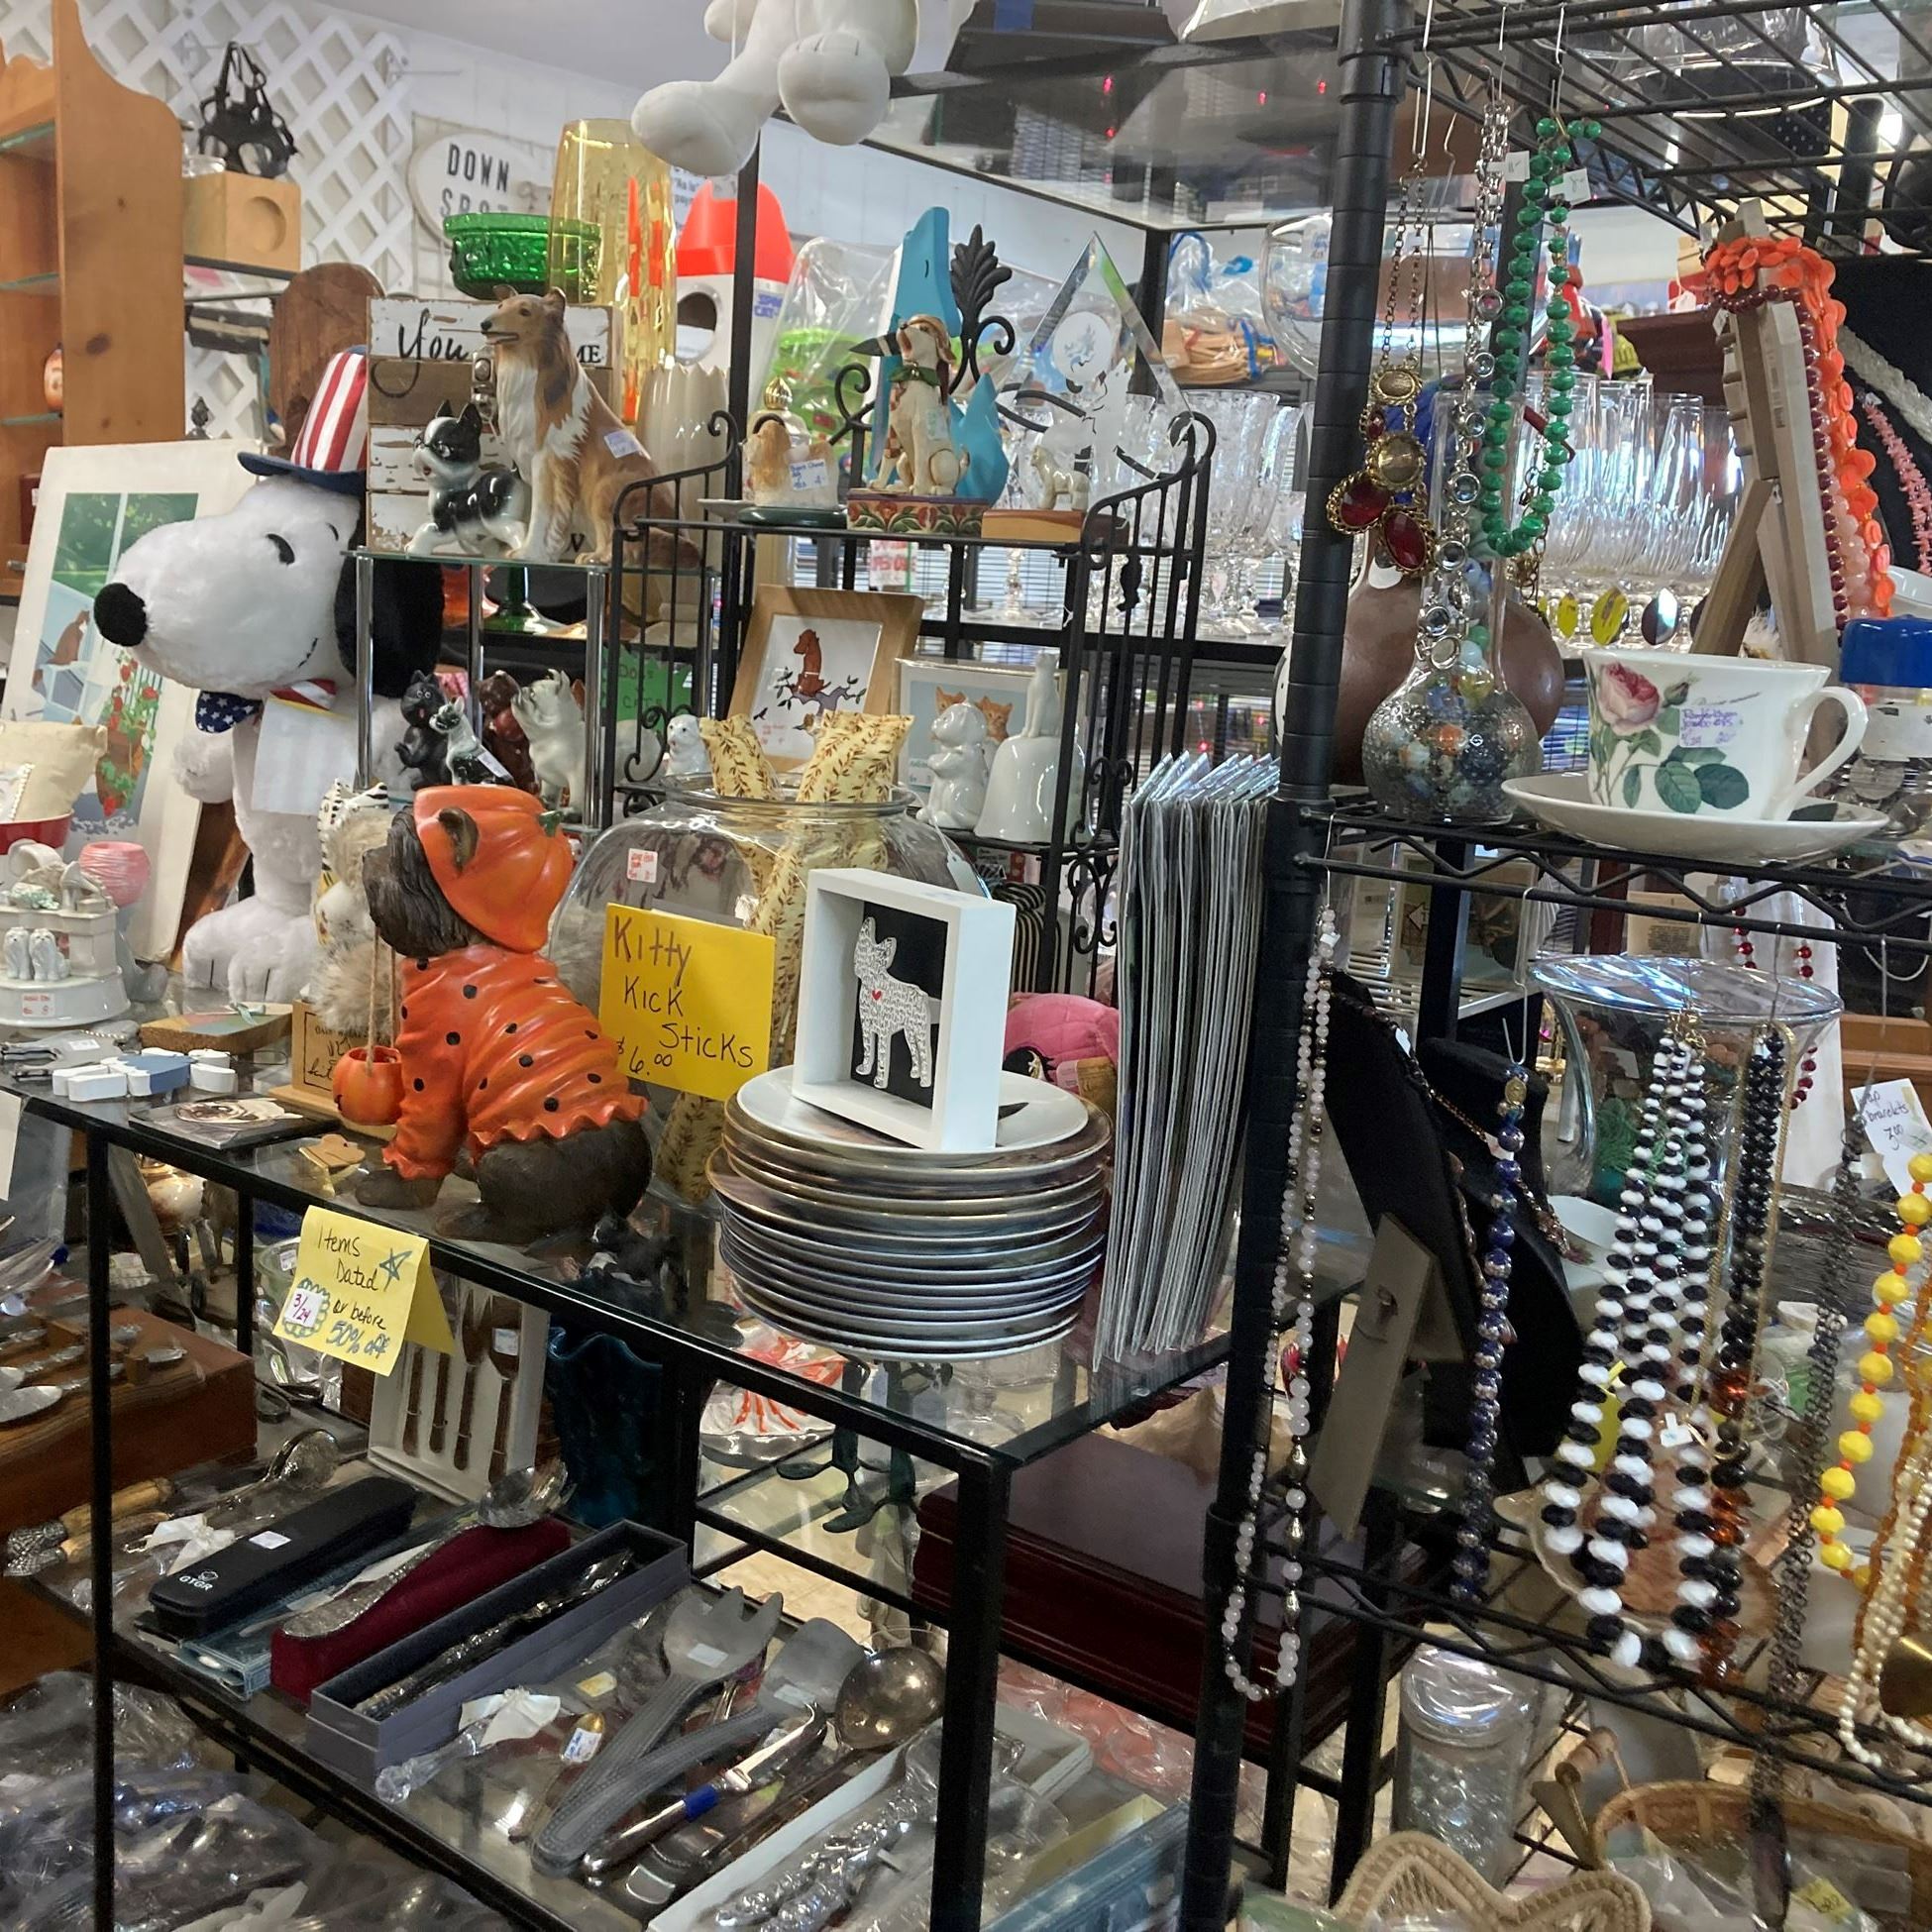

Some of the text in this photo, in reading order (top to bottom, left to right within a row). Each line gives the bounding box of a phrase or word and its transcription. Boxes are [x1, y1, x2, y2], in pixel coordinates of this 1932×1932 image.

[447, 143, 509, 193] DOWN
[372, 308, 469, 398] You
[614, 915, 692, 989] Kitty
[317, 1224, 361, 1257] Items
[337, 1258, 379, 1292] Dated
[293, 1293, 312, 1324] 3/24
[333, 1299, 386, 1331] or before
[325, 1320, 366, 1354] 50%
